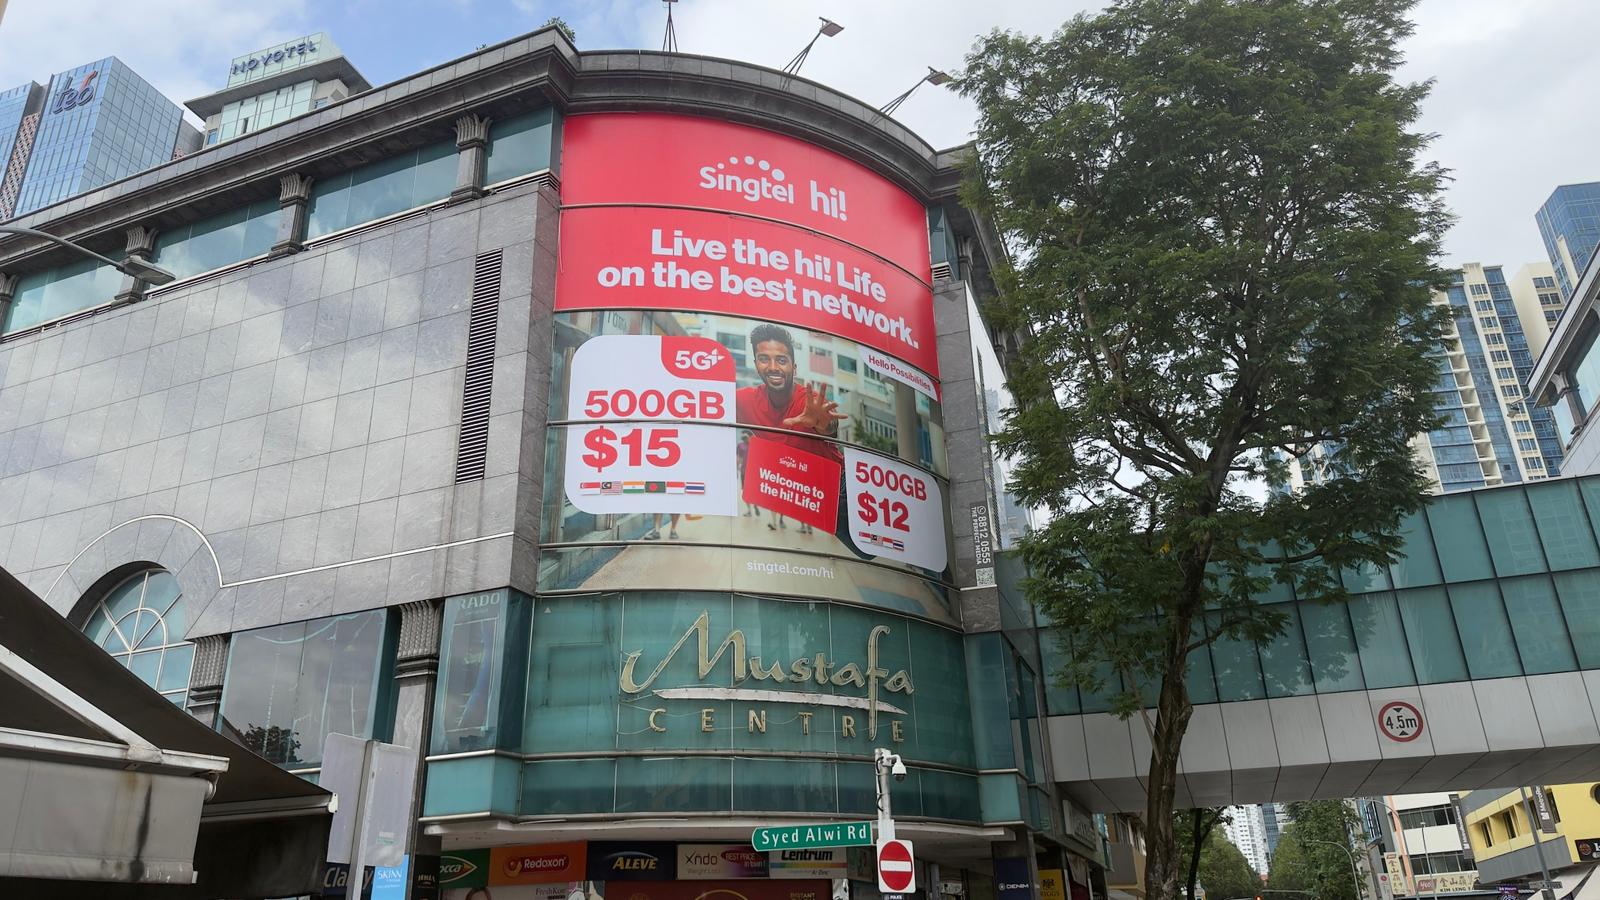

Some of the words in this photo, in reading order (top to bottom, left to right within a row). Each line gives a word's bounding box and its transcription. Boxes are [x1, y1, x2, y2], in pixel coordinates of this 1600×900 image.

[232, 40, 316, 75] NOVOTEL
[700, 161, 793, 204] Singtel
[810, 179, 847, 222] hi!
[652, 228, 726, 260] Live
[732, 237, 789, 270] the
[795, 249, 831, 283] hi!
[837, 261, 887, 303] Life
[597, 266, 644, 288] on
[653, 261, 713, 291] the
[720, 266, 797, 305] best
[802, 286, 919, 349] network.
[868, 354, 890, 371] Hello
[890, 363, 931, 392] Possibilities
[584, 388, 725, 420] 500GB
[582, 425, 681, 473] $15
[759, 467, 811, 494] Welcome
[812, 486, 825, 500] to
[855, 461, 928, 501] 500GB
[760, 482, 778, 497] the
[779, 488, 794, 503] hi!
[794, 493, 821, 513] Life!
[857, 491, 910, 532] $12
[972, 520, 980, 543] PERFECT
[978, 516, 988, 539] 8812
[980, 540, 991, 564] 0555
[746, 560, 835, 579] singtel.com/hi
[457, 592, 500, 609] RADO
[620, 608, 915, 741] Mustafa
[648, 707, 905, 742] CENTRE
[1386, 715, 1417, 729] 4.5m
[761, 828, 799, 847] Syed
[805, 827, 841, 842] Alwi
[847, 825, 867, 840] Rd
[524, 857, 565, 869] Redoxon
[612, 857, 657, 870] ALEVE
[685, 851, 718, 865] Xndo
[781, 850, 833, 861] Centrum
